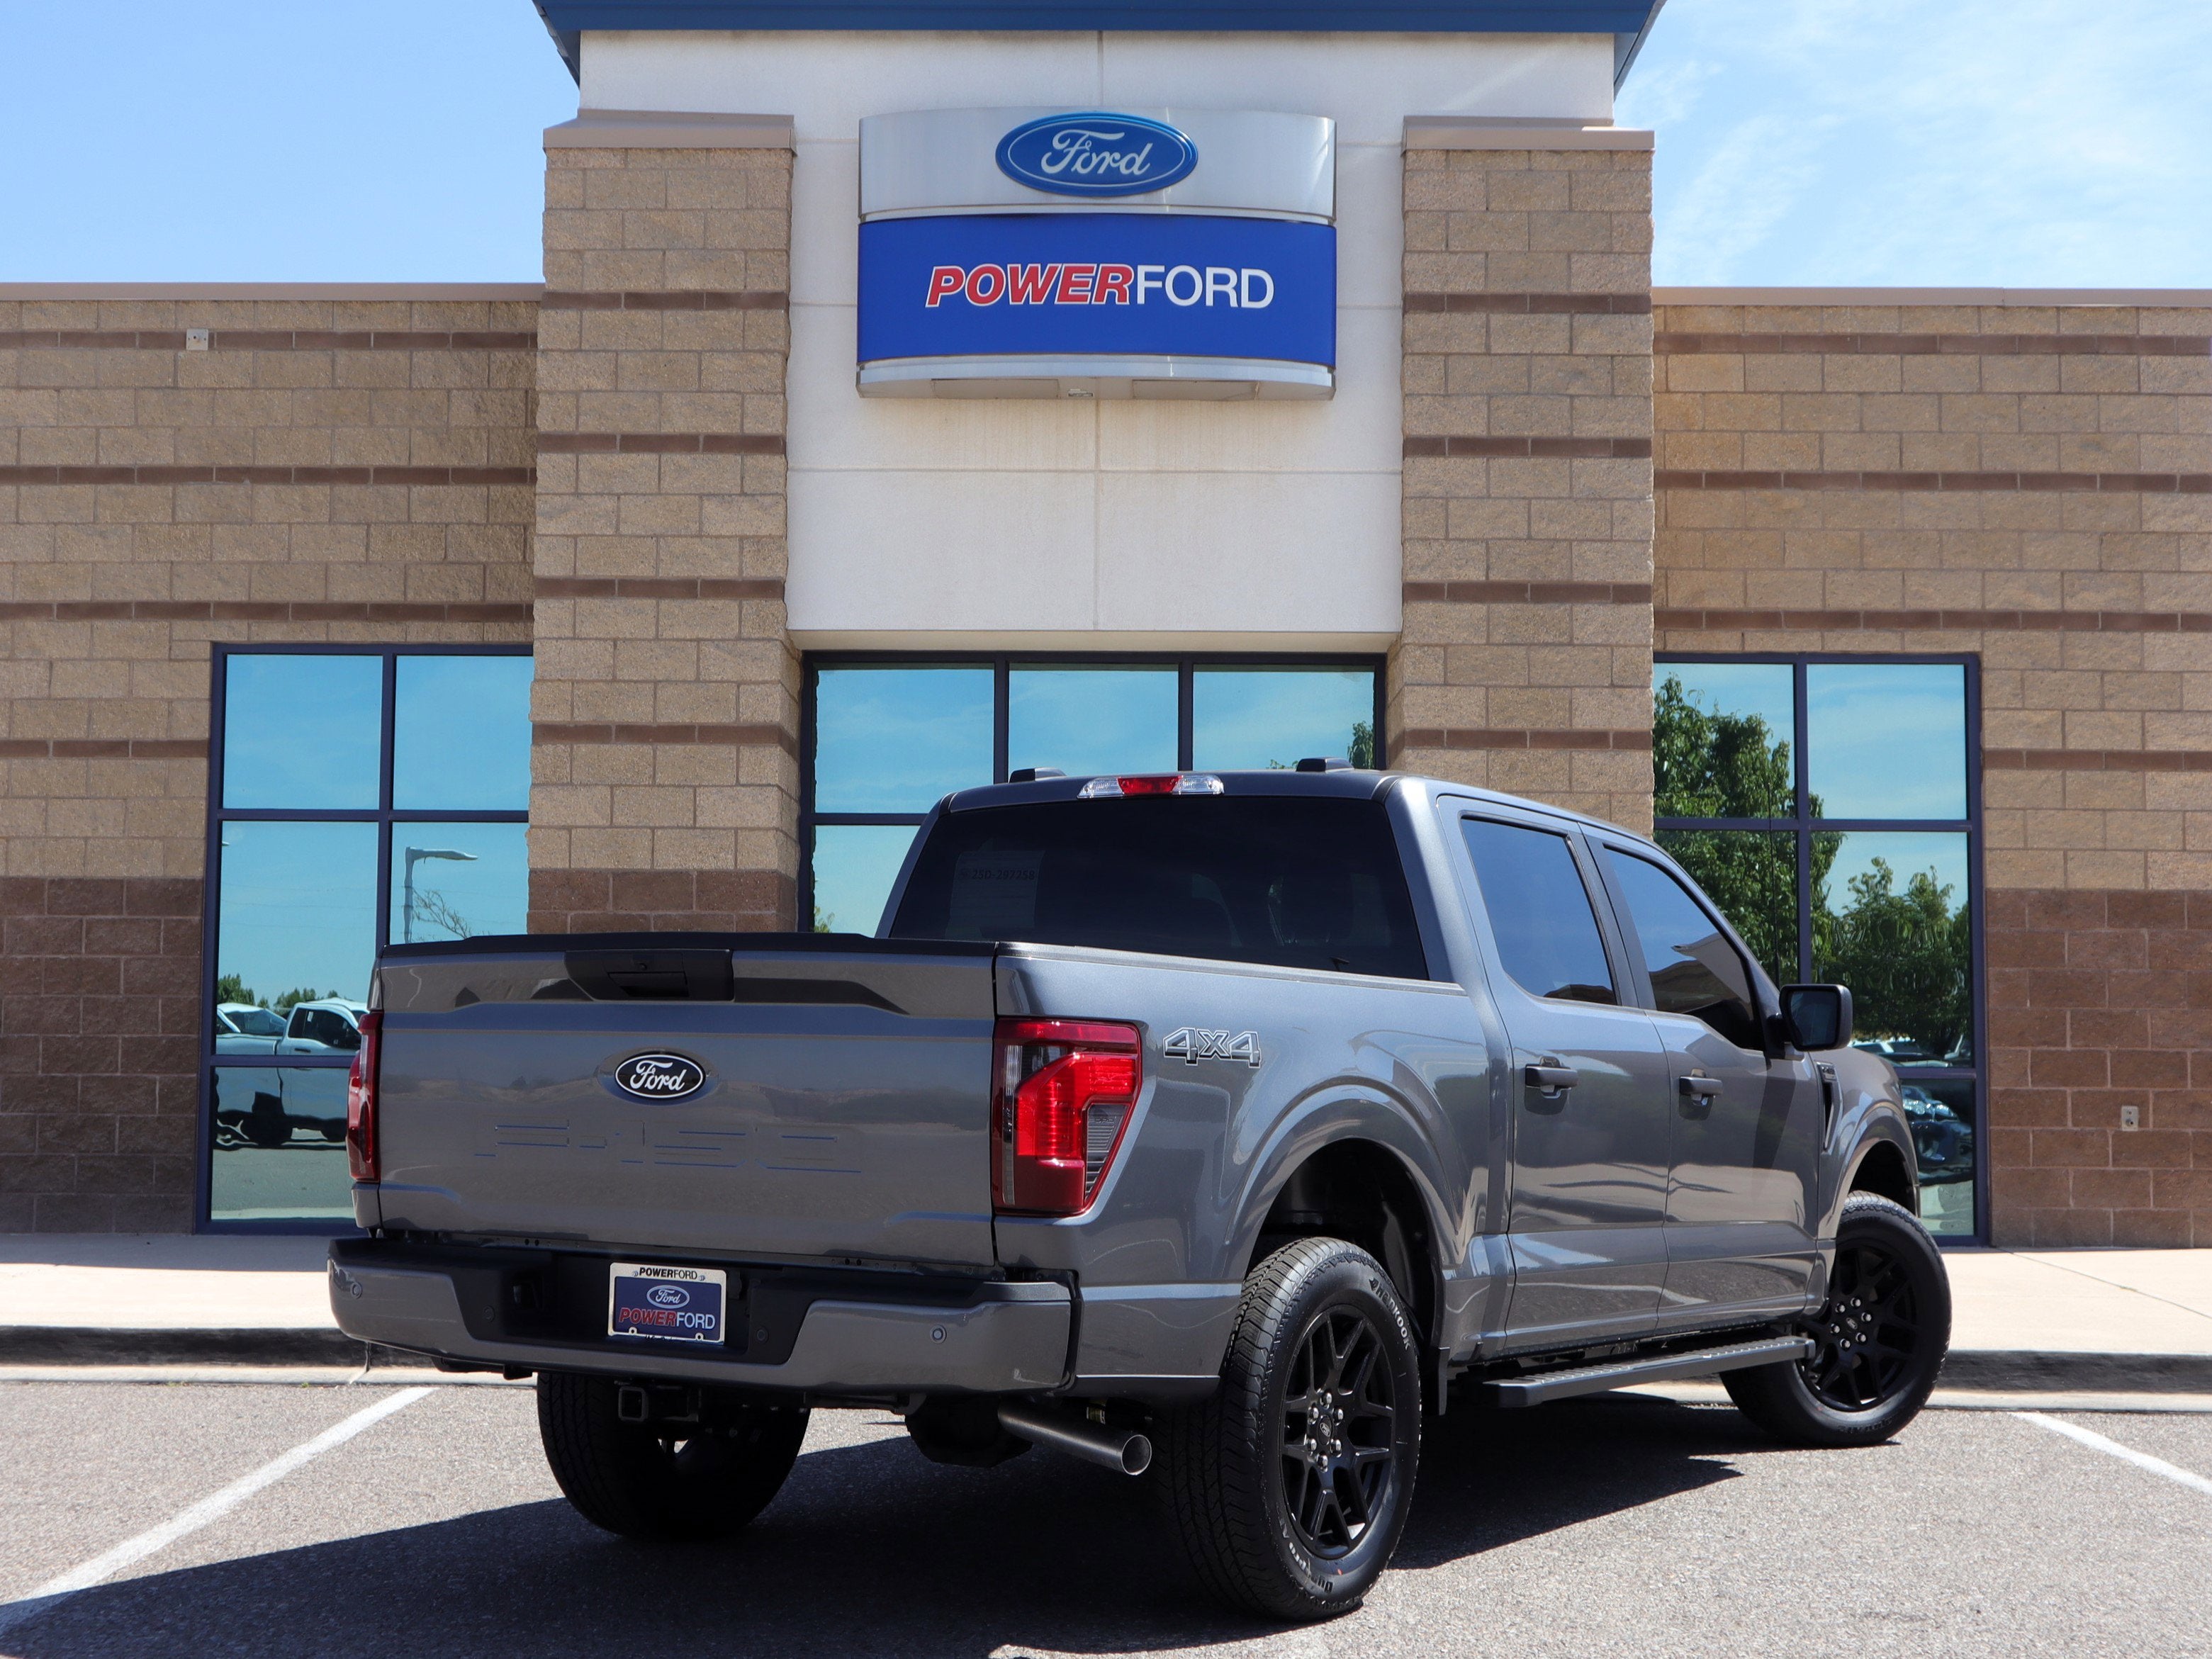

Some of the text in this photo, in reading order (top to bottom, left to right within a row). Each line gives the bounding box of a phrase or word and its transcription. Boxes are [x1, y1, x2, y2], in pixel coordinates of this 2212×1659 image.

[1040, 128, 1153, 176] Ford
[630, 1060, 687, 1091] Ford
[656, 1288, 680, 1304] Ford
